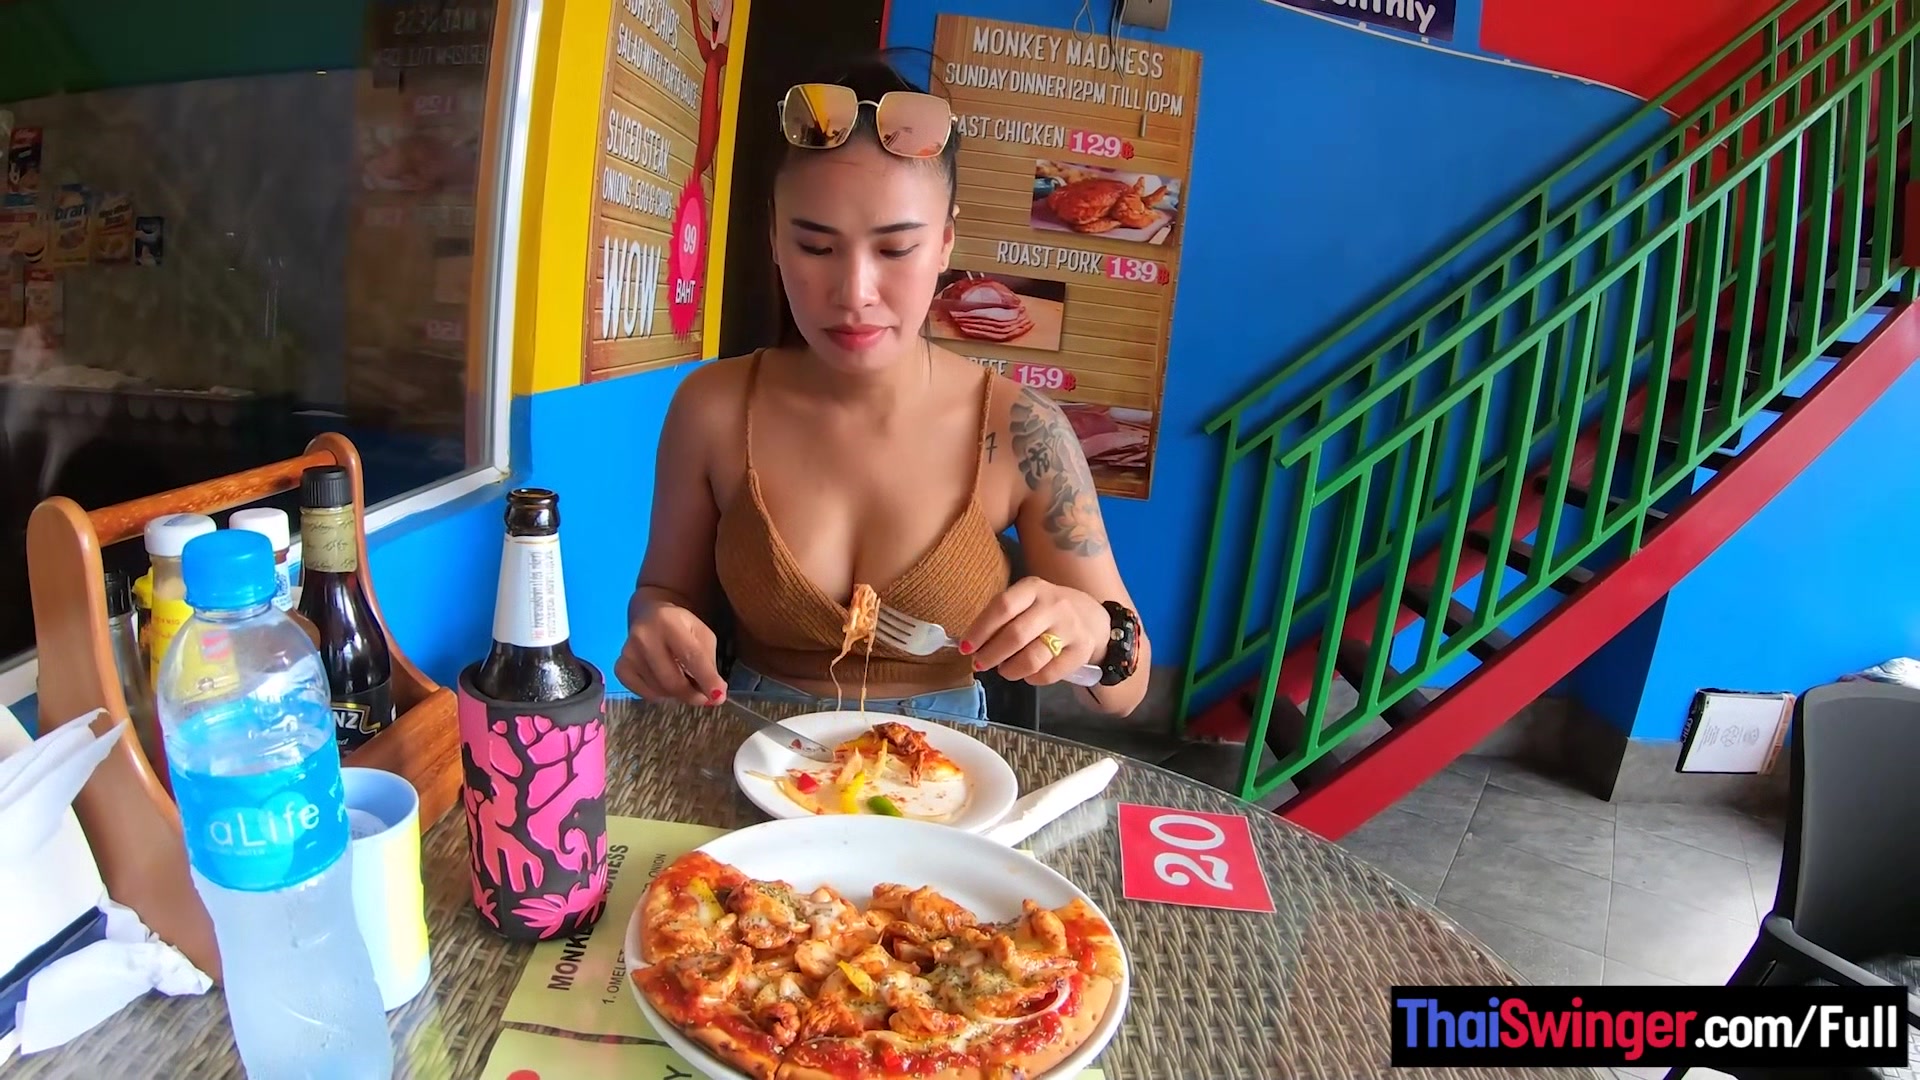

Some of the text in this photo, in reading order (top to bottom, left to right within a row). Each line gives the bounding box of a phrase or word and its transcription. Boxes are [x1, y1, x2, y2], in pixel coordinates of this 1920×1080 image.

[617, 22, 643, 69] SALAD
[642, 41, 662, 83] WITH
[972, 26, 1164, 79] MONKEY MADNESS
[945, 63, 1183, 117] SUNDAY DINNER 12PM TILL 10PM
[606, 109, 643, 164] SLICED
[957, 114, 991, 138] AST
[994, 118, 1065, 148] CHICKEN
[634, 179, 651, 213] EGG
[655, 187, 673, 220] CHIPS
[682, 222, 698, 254] 99
[997, 240, 1051, 269] ROAST
[1056, 250, 1102, 275] PORK
[602, 235, 662, 339] WOW
[675, 279, 696, 304] BAHT
[209, 801, 320, 848] aLife
[1150, 814, 1233, 891] 20
[547, 844, 628, 991] MONKE DNESS
